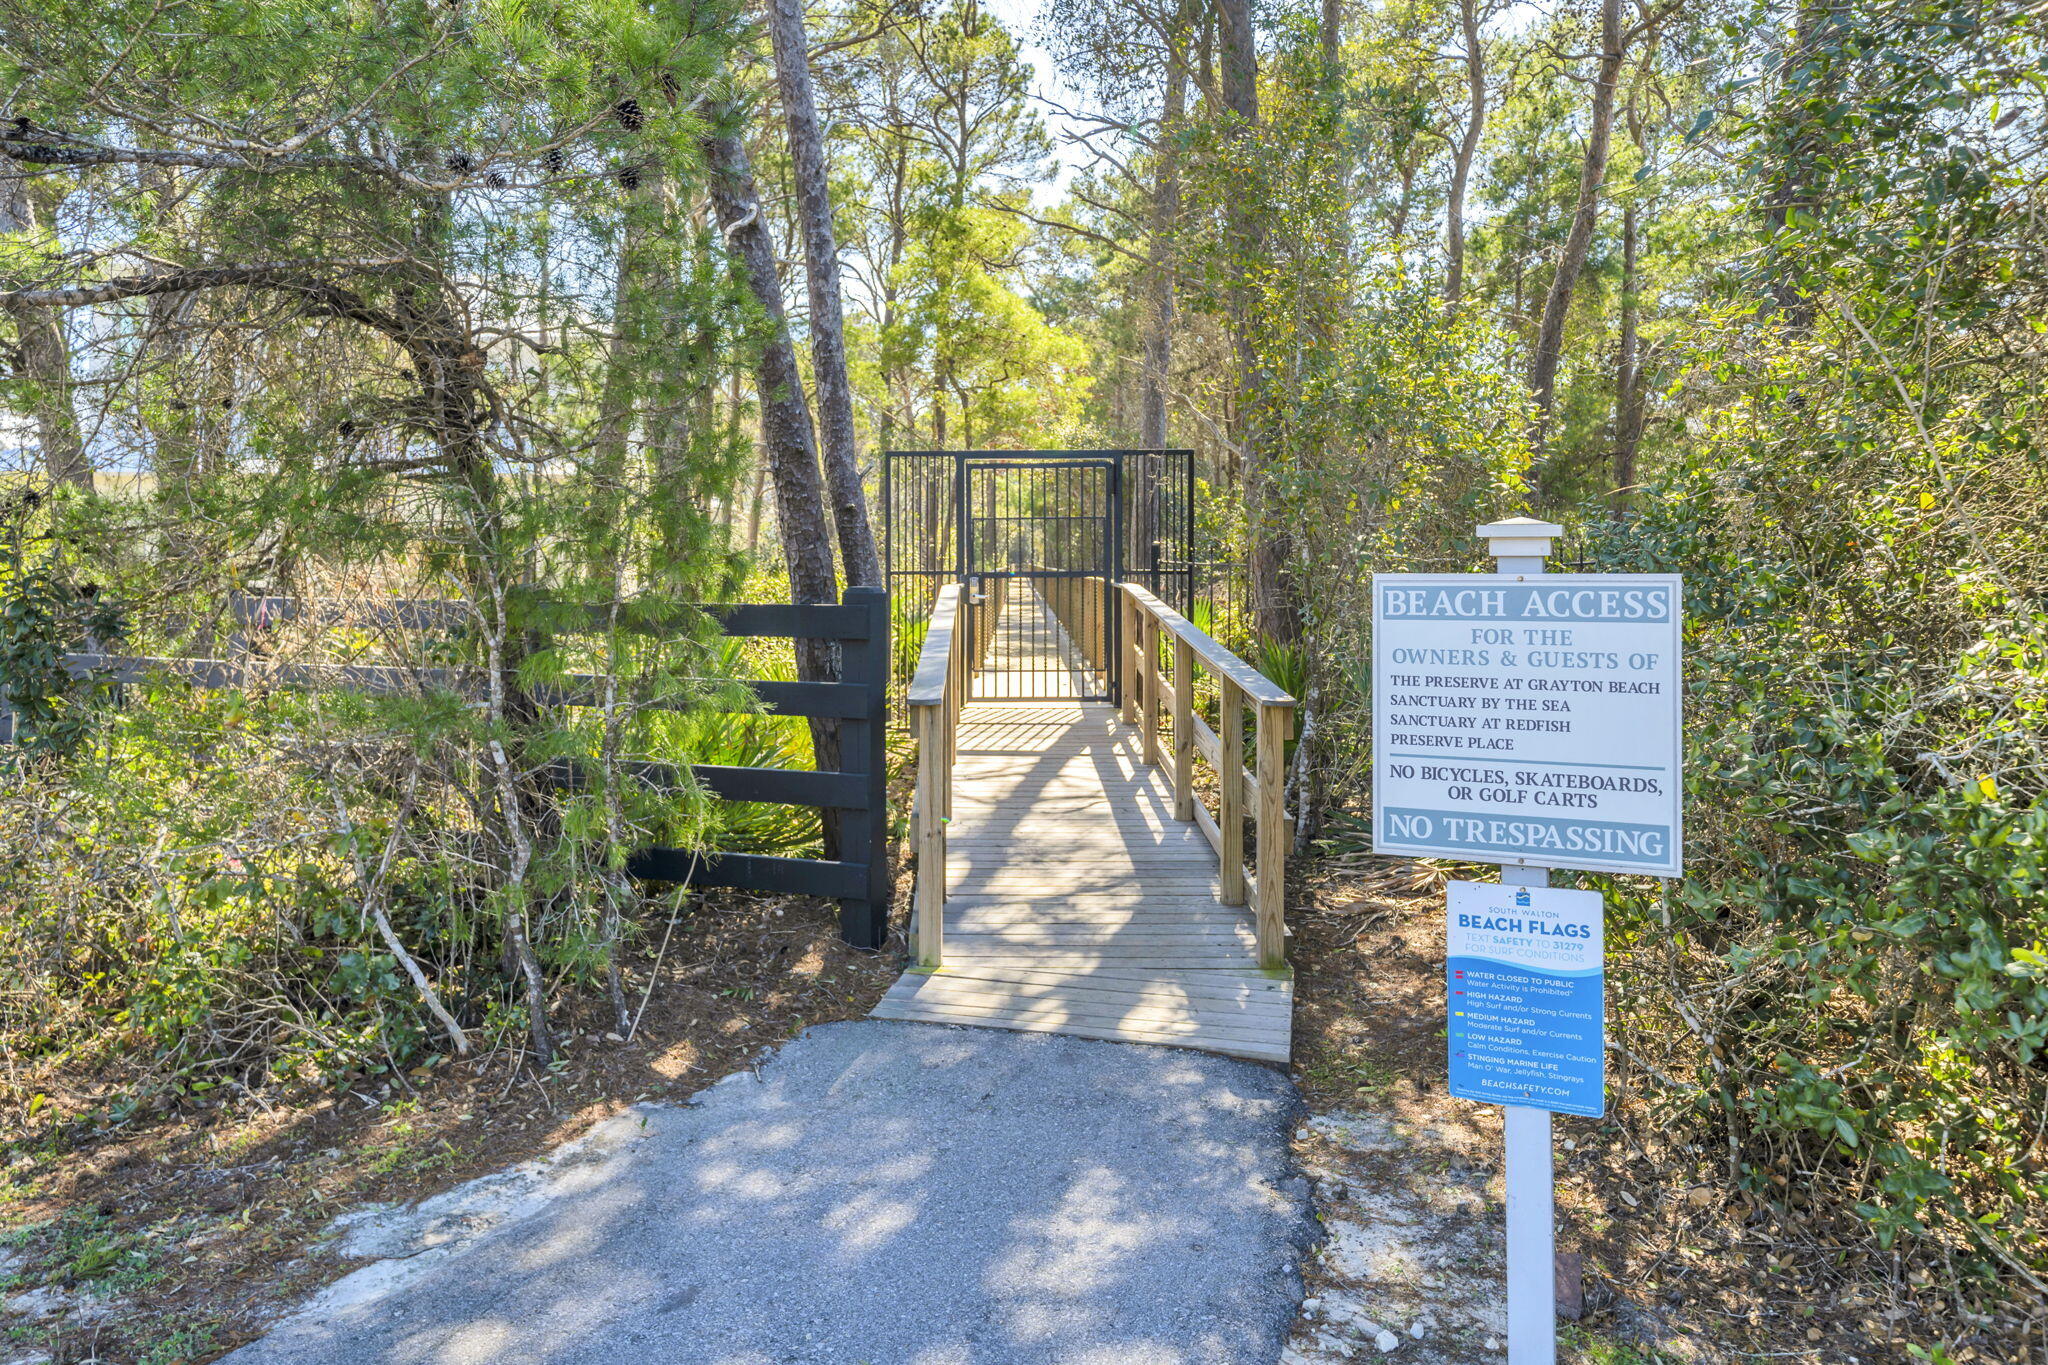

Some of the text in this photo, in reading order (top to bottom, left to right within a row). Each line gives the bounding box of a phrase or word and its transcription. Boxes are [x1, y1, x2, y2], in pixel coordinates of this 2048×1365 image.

[1385, 590, 1667, 618] BEACH ACCESS
[1471, 628, 1572, 646] FOR THE
[1392, 648, 1659, 670] OWNERS & GUESTS OF
[1391, 675, 1660, 694] THE PRESERVE AT GRAYTON BEACH
[1390, 694, 1571, 712] SANCTUARY BY THE SEA
[1390, 714, 1571, 733] SANCTUARY AT REDFISH
[1390, 733, 1514, 750] PRESERVE PLACE
[1390, 764, 1663, 796] NO BICYCLES, SKATEBOARDS,
[1448, 786, 1597, 808] OR GOLF CARTS
[1389, 814, 1663, 857] NO TRESPASSING
[1488, 906, 1559, 918] SOUTH WALTON
[1459, 914, 1591, 939] BEACH FLAGS
[1466, 933, 1584, 951] TEXT SAFETY TO 31279
[1465, 944, 1584, 963] FOR SURF CONDITIONS
[1467, 970, 1495, 979] WATER
[1497, 974, 1528, 983] CLOSED
[1545, 979, 1574, 988] PUBLIC
[1467, 979, 1489, 987] Water
[1491, 982, 1520, 992] Activity
[1467, 991, 1523, 1003] HIGH HAZARD
[1467, 1000, 1592, 1020] High Surf and/or Strong Currents
[1467, 1012, 1535, 1026] MEDIUM HAZARD
[1467, 1021, 1582, 1041] Moderate Surf and/or Currents
[1467, 1033, 1522, 1045] LOW HAZARD
[1467, 1042, 1486, 1050] Calm
[1532, 1051, 1564, 1060] Exercise
[1566, 1054, 1596, 1063] Caution
[1467, 1053, 1558, 1071] STINGING MARINE LIFE
[1467, 1062, 1483, 1070] Man
[1548, 1072, 1584, 1083] Stingrays
[1481, 1079, 1570, 1096] BEACHSAFETY.COM
